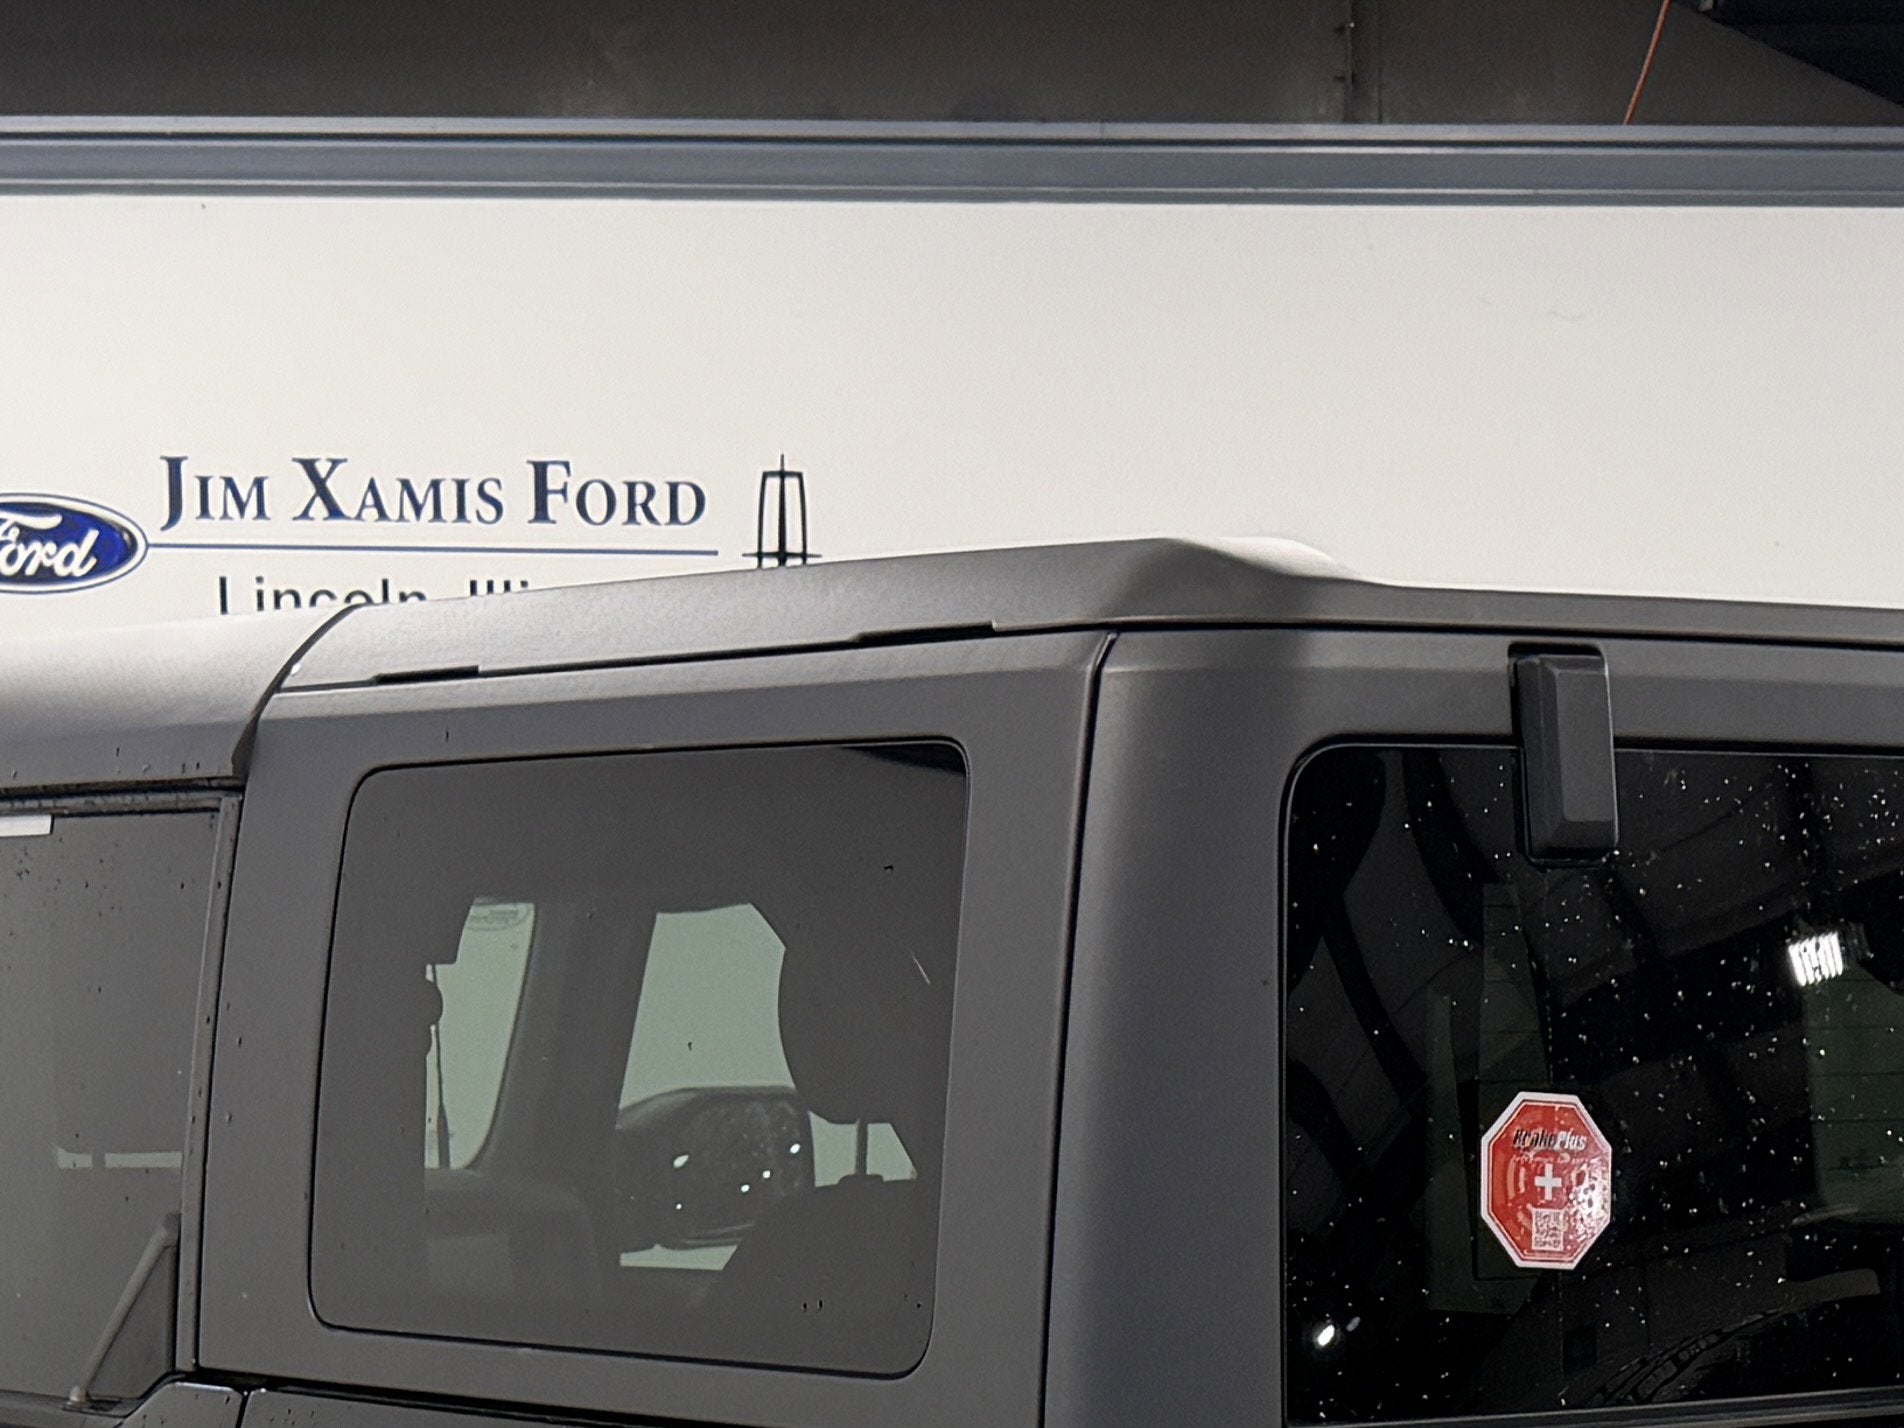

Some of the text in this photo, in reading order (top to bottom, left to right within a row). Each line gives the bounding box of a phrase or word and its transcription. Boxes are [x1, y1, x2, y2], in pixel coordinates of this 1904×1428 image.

[159, 456, 707, 531] JIM XAMIS FORD
